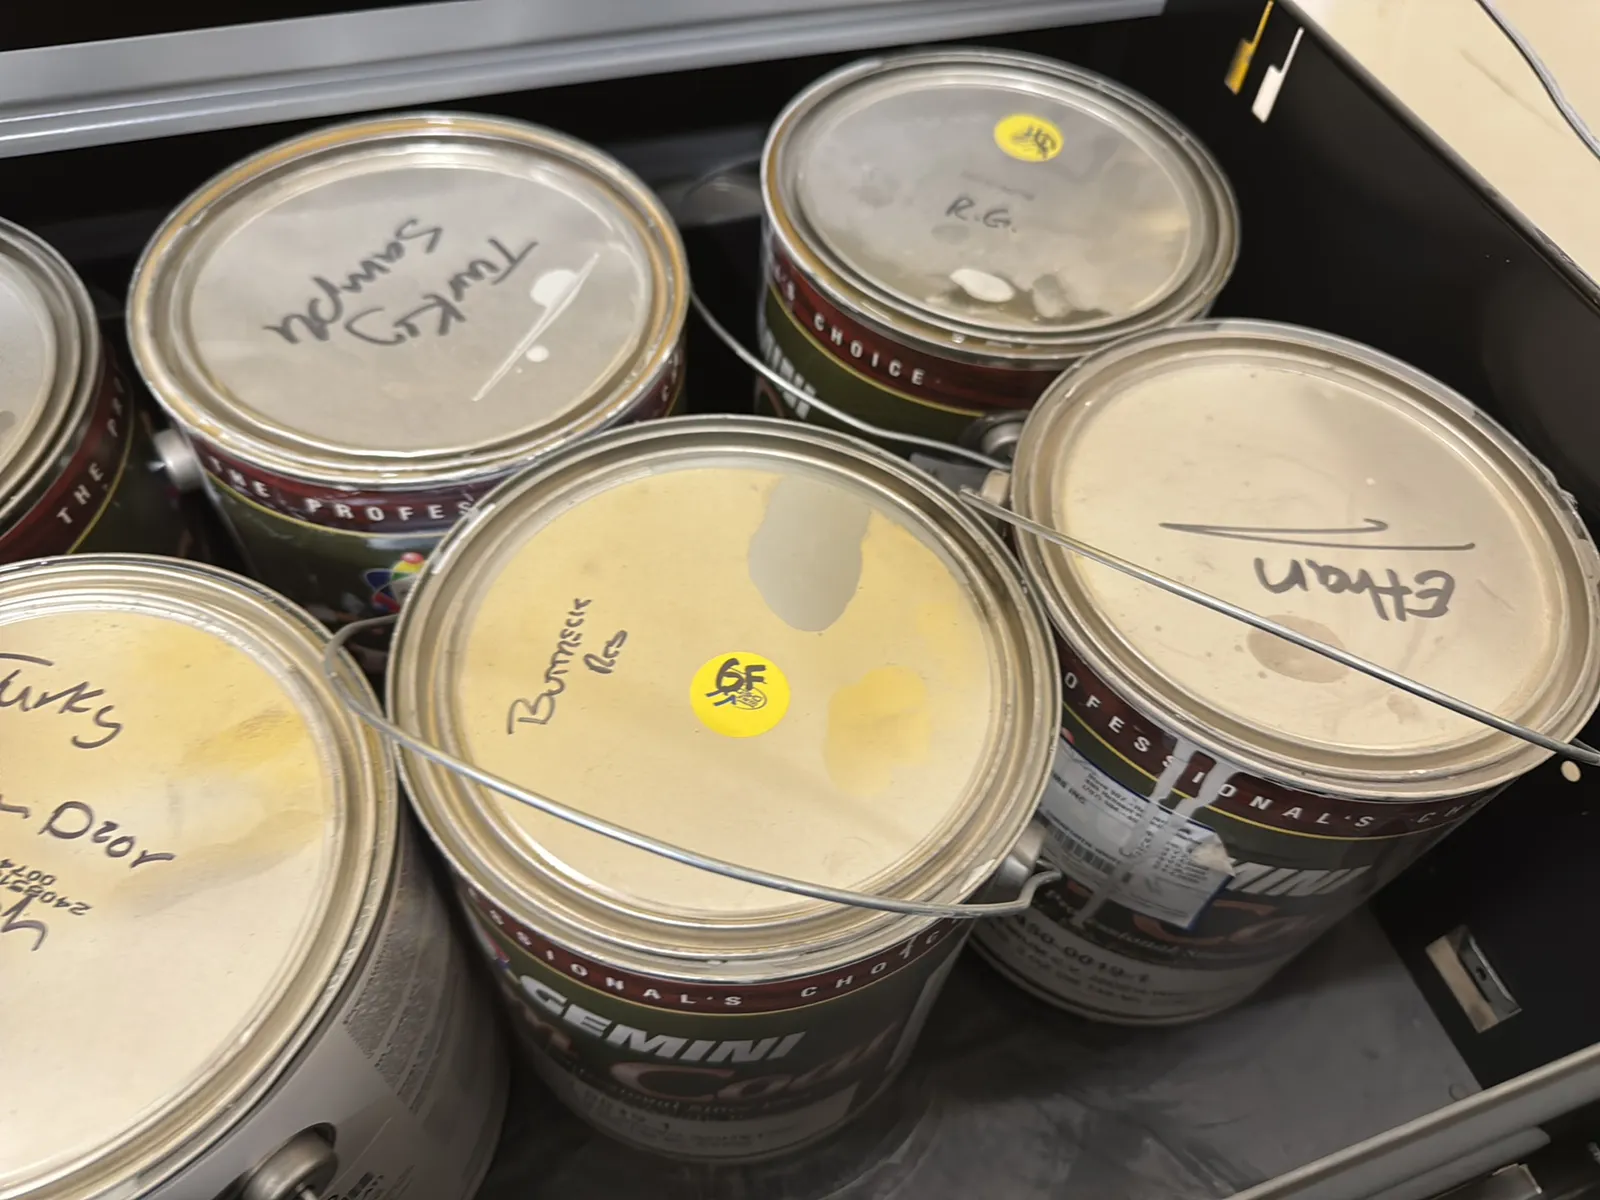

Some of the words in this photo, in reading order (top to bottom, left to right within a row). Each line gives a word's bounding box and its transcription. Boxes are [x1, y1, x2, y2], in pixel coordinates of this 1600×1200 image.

[813, 312, 926, 386] CHOICE
[55, 462, 105, 526] THE
[208, 456, 272, 500] THE
[1253, 556, 1456, 623] Ethan
[519, 974, 807, 1063] GEMINI
